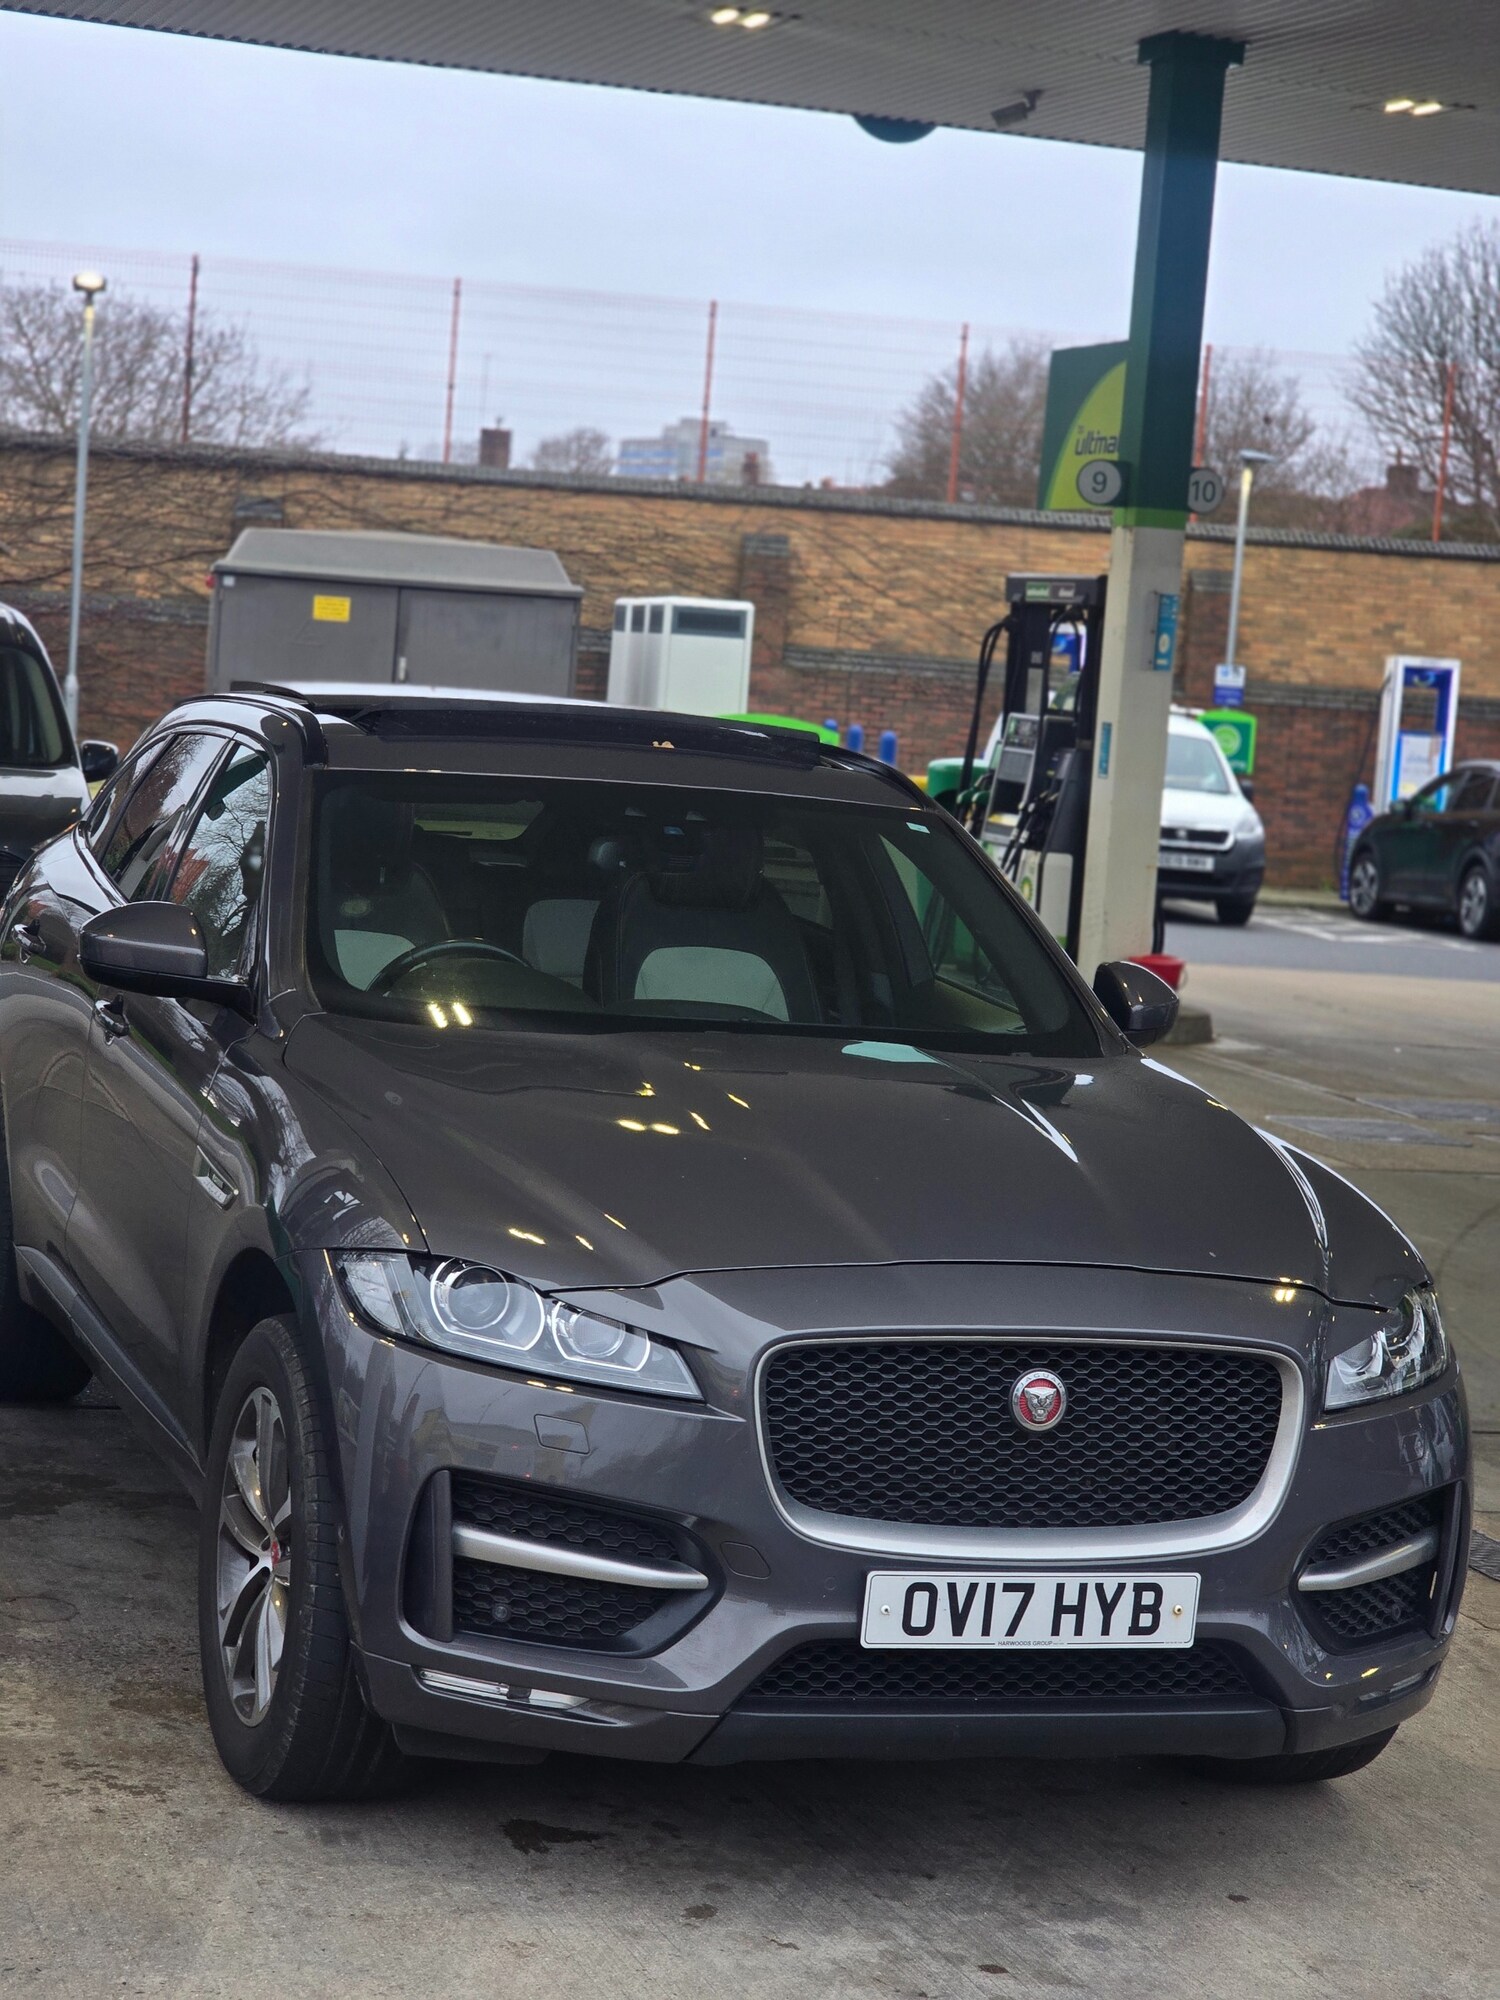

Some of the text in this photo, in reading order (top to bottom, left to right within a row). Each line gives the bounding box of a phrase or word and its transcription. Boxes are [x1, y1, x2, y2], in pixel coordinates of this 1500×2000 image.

[1091, 471, 1107, 493] 9
[1191, 480, 1216, 503] 10
[1020, 1372, 1063, 1389] JAGUAR
[902, 1581, 1164, 1637] OV17 HYB
[997, 1640, 1053, 1648] HARWOODS GROUP
